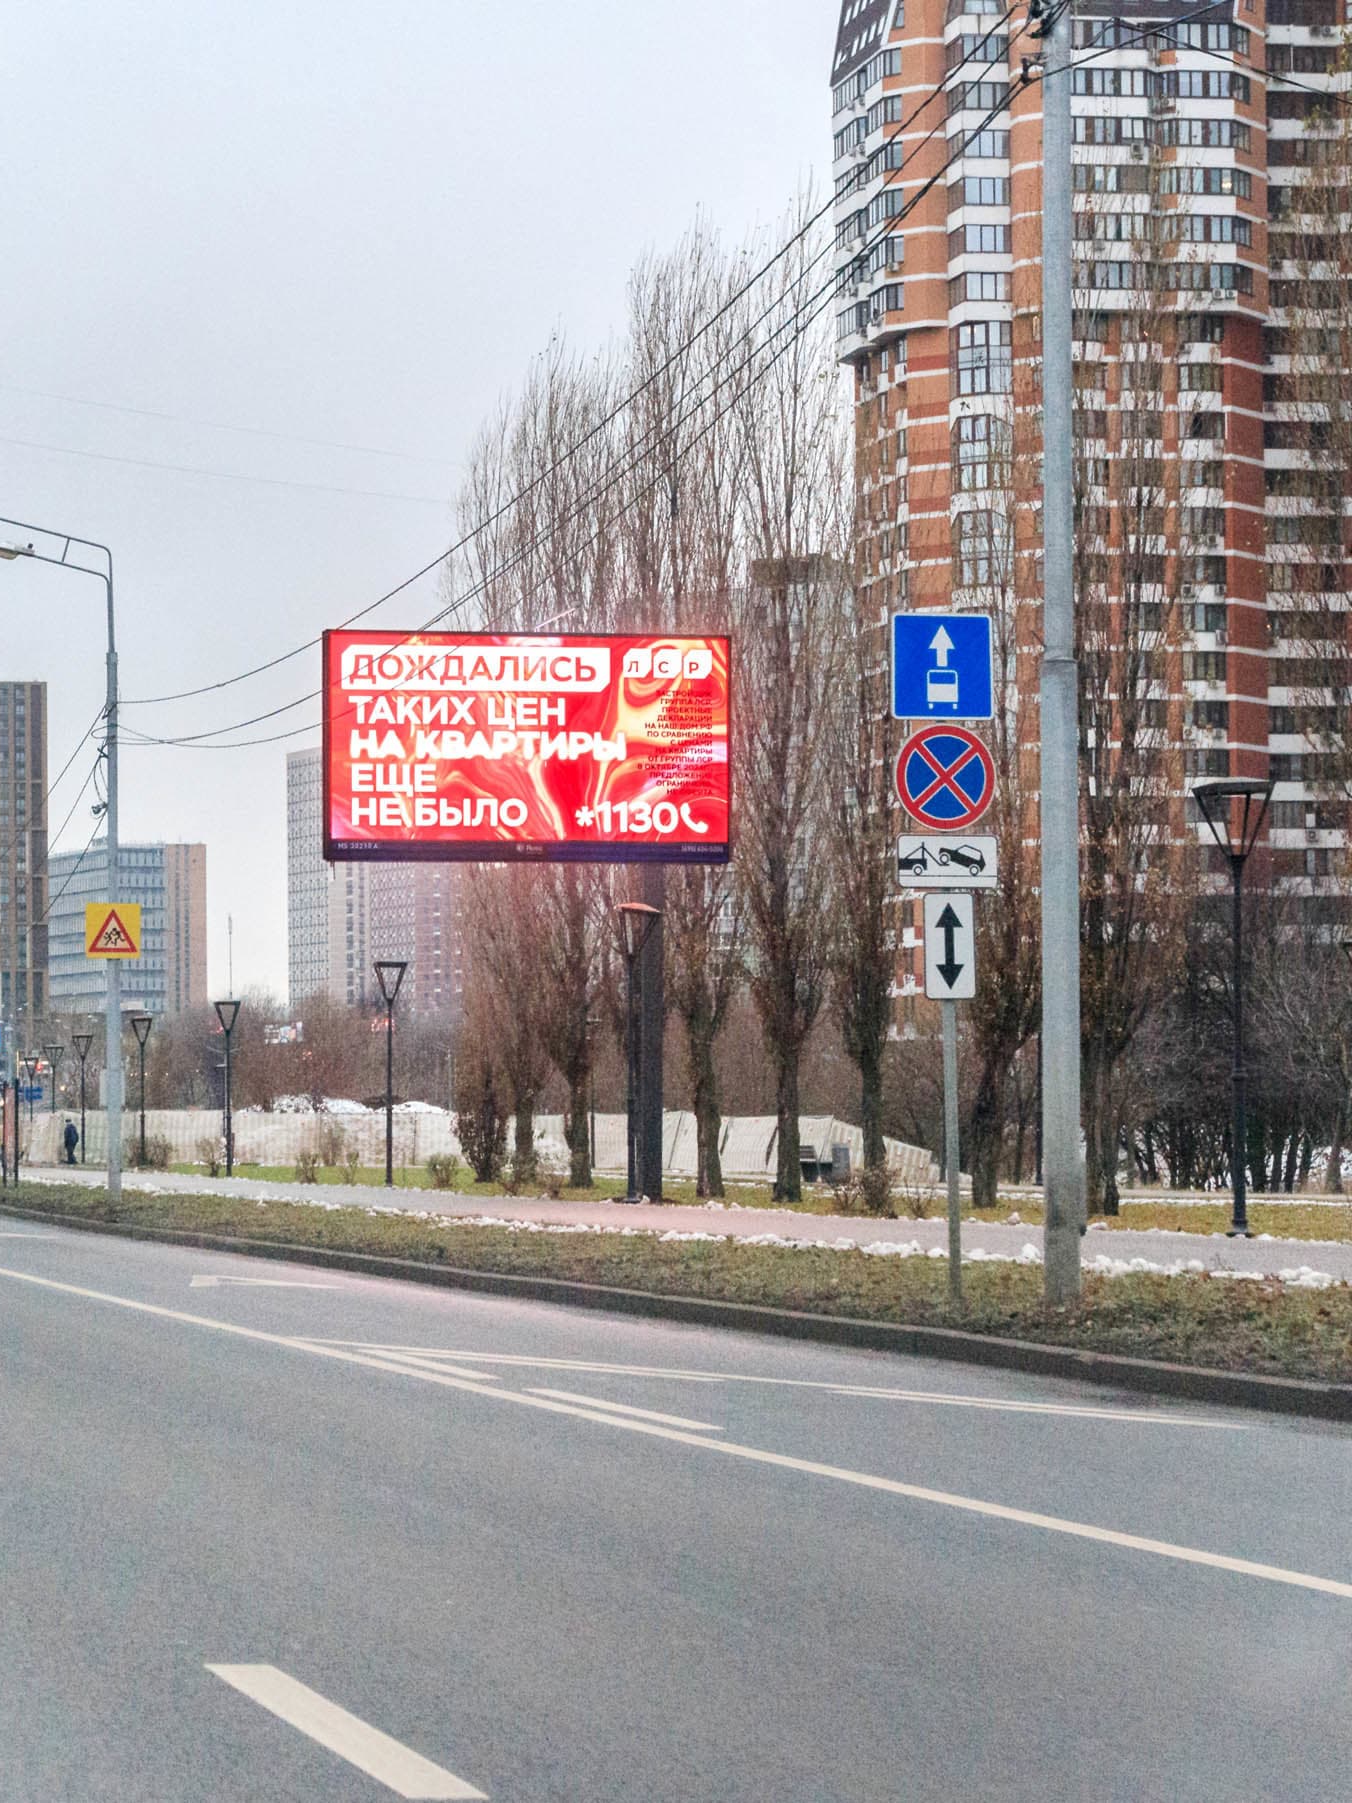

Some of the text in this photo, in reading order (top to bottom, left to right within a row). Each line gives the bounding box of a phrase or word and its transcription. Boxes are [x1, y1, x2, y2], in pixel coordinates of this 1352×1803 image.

[349, 654, 597, 685] ДОЖДАЛИСЬ
[628, 660, 699, 674] ЛСР
[348, 695, 566, 730] ТАКИХ ЦЕН
[349, 729, 627, 760] НА КВАРТИРЫ
[647, 730, 712, 738] ПО СРАВНЕНИЮ
[351, 763, 437, 797] ЕЩЕ
[351, 797, 528, 827] НЕ БЫЛО
